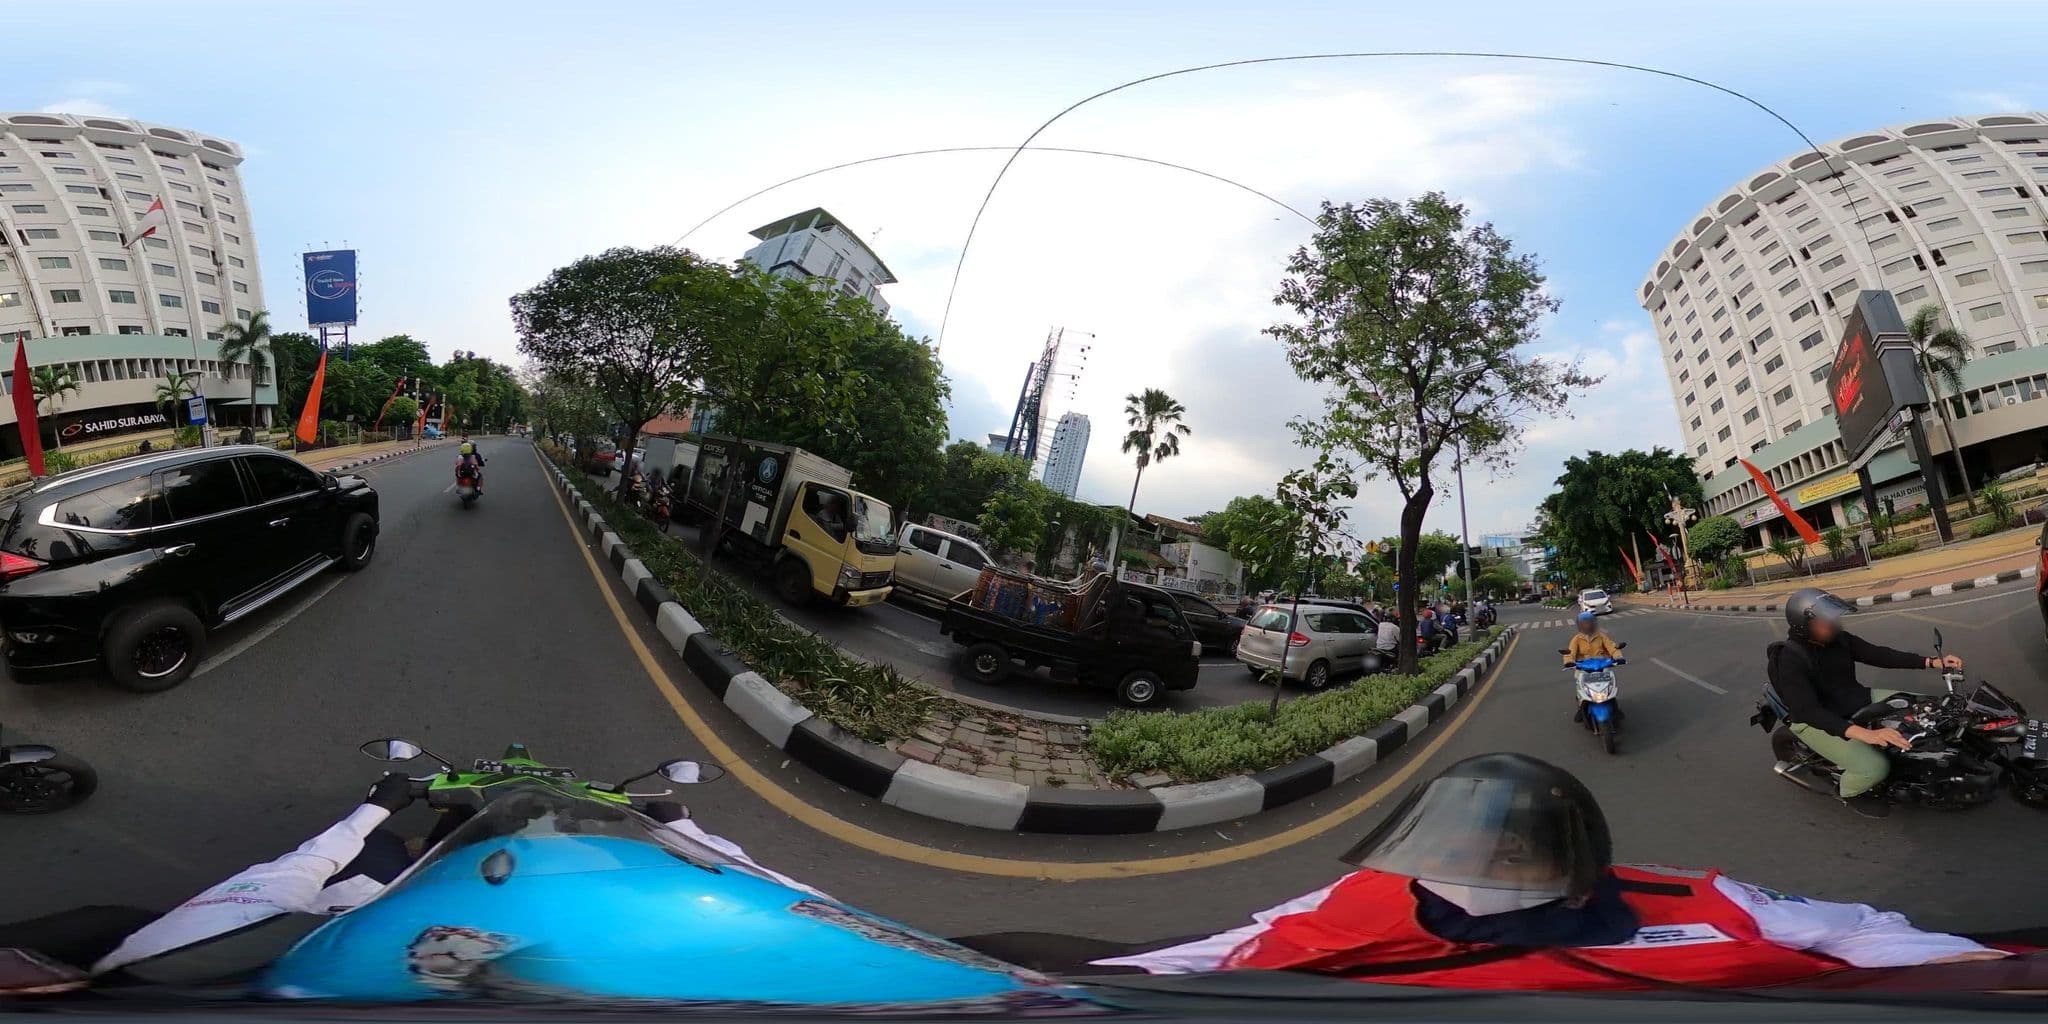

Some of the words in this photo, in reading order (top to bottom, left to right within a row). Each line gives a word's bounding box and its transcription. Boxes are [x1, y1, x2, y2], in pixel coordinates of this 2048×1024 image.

[85, 419, 117, 433] SAHID
[119, 413, 166, 428] SURABAYA
[752, 485, 773, 497] OFFICIAL
